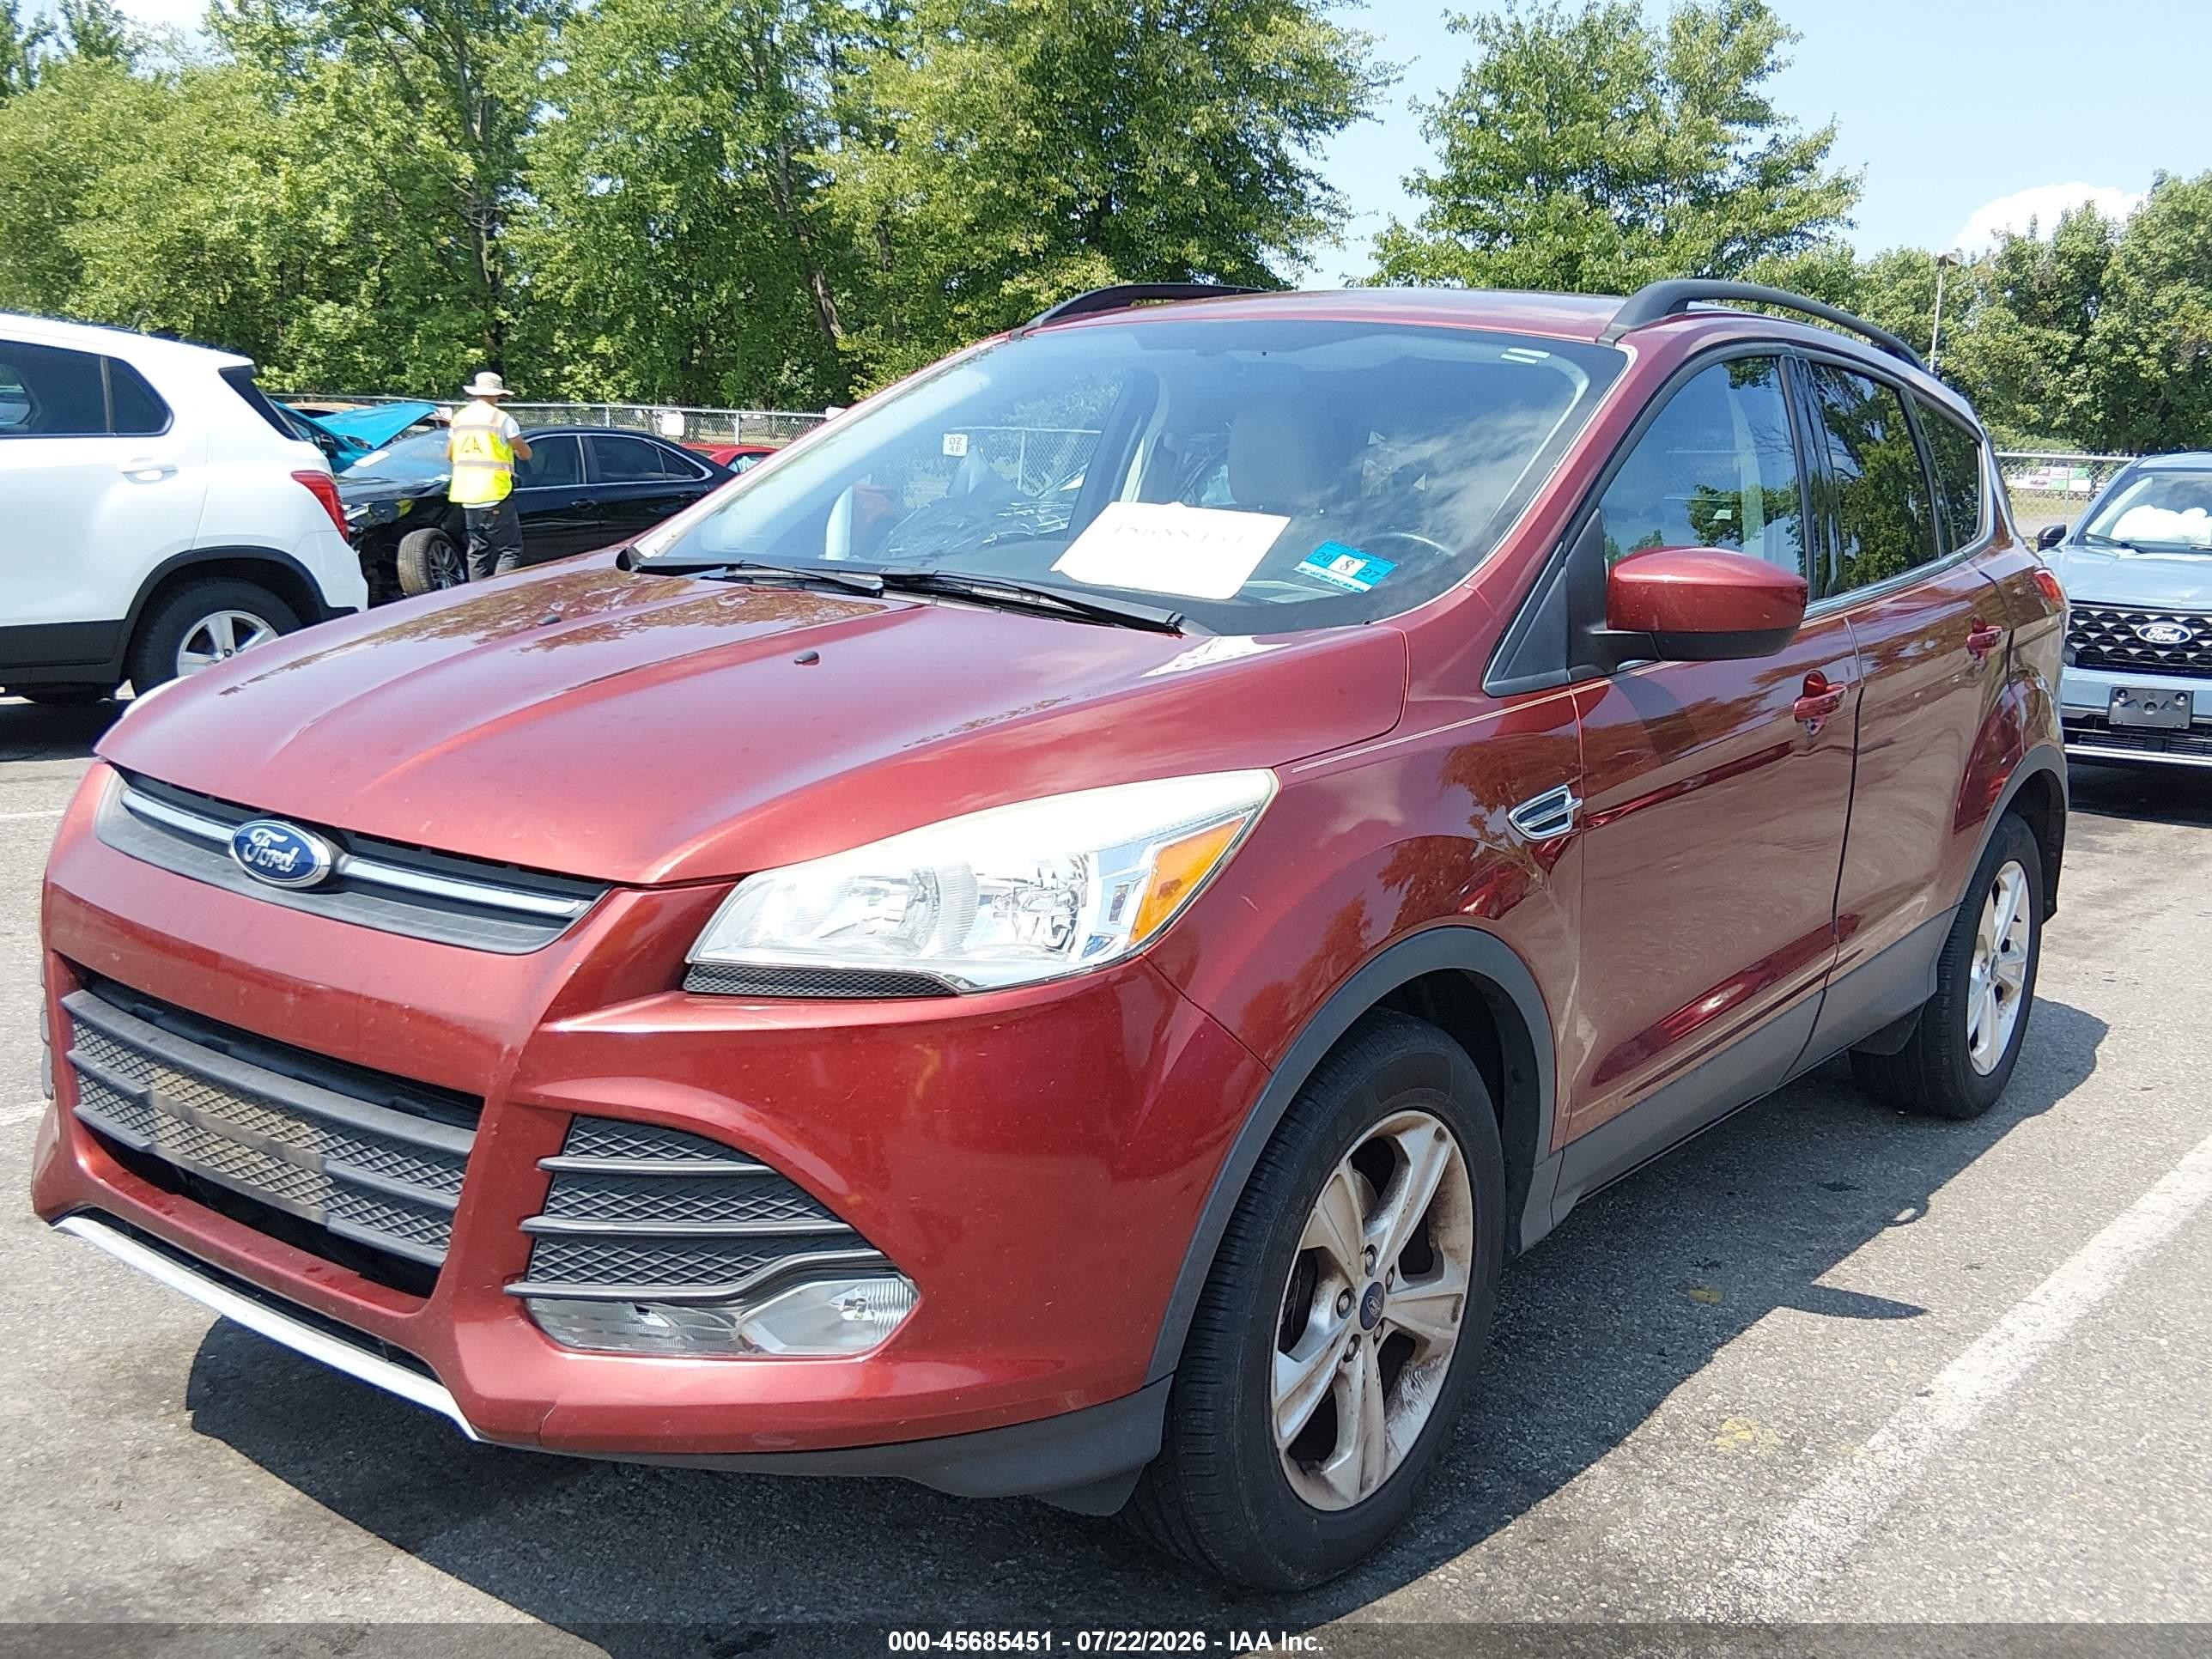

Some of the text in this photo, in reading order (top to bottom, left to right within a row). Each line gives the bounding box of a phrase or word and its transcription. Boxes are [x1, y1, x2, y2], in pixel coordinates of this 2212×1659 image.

[1313, 551, 1382, 579] 20 8 27
[2145, 627, 2182, 641] Ford
[243, 828, 301, 872] Ford
